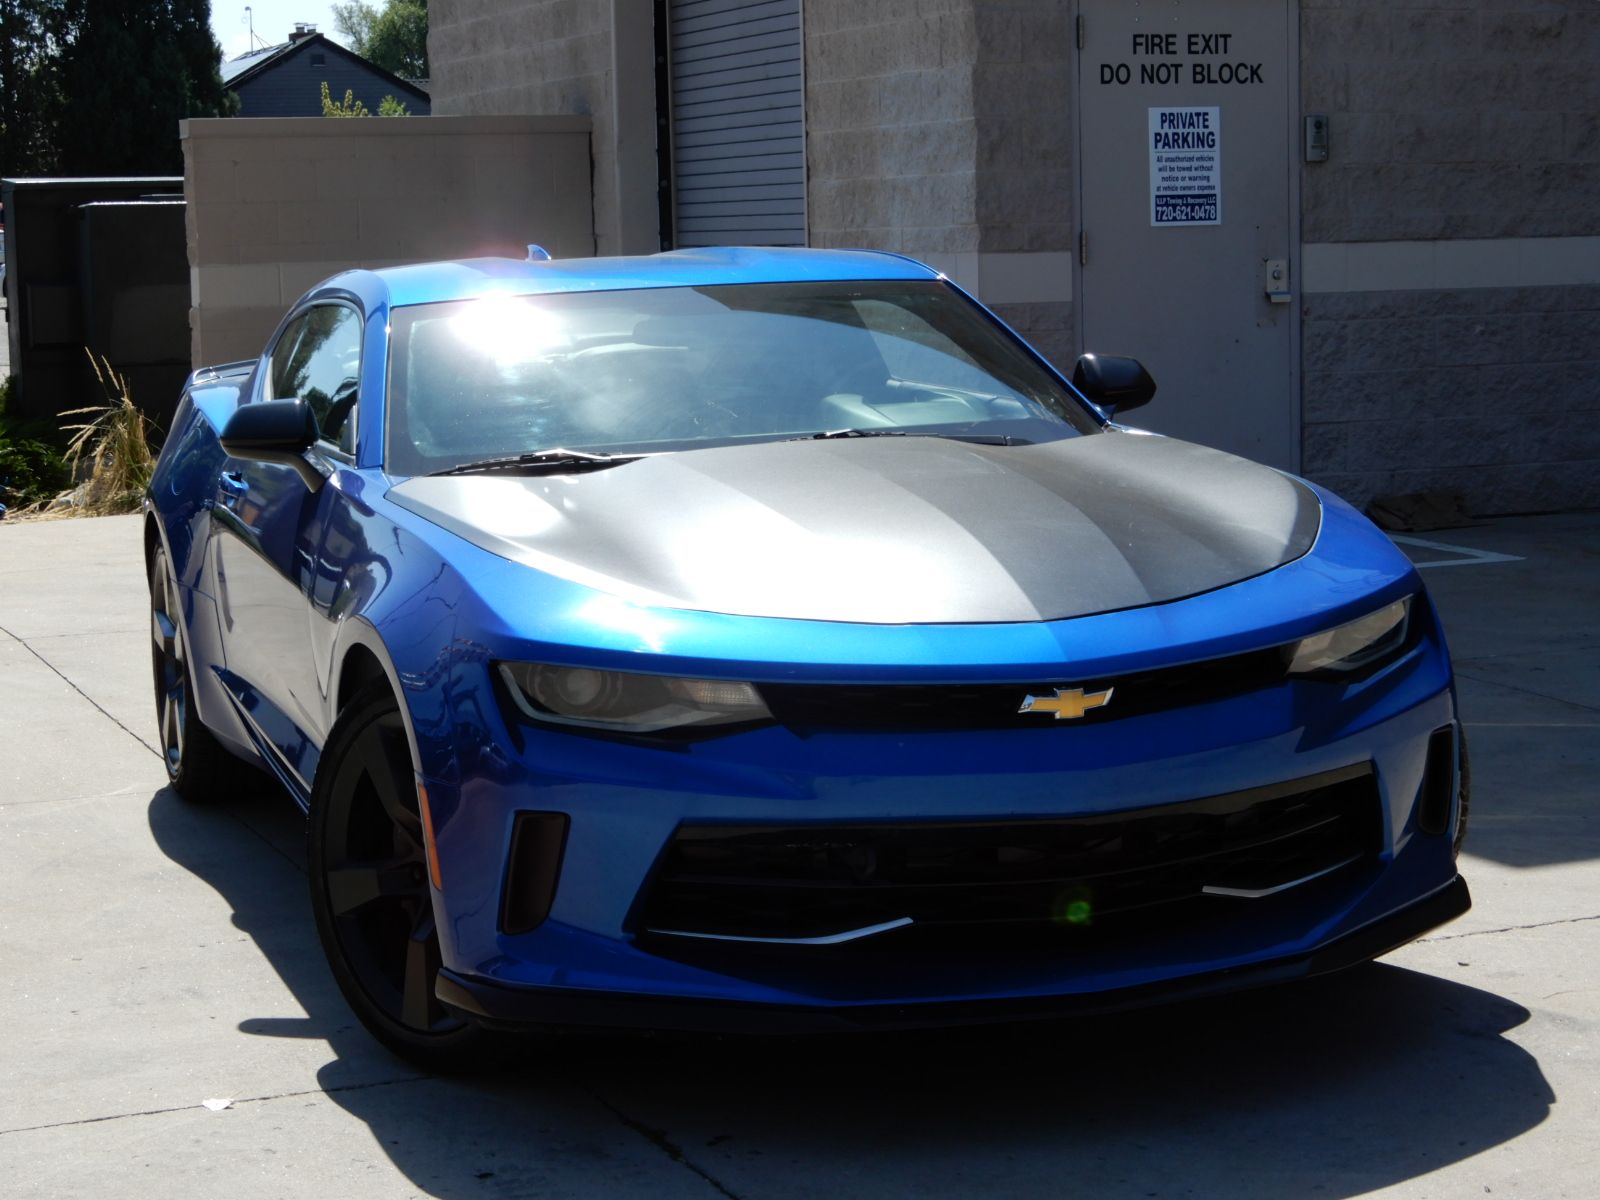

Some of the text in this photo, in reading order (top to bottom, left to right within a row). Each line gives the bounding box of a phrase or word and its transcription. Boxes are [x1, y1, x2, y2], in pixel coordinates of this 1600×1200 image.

[1133, 34, 1232, 55] FIRE EXIT
[1100, 63, 1263, 85] DO NOT BLOCK
[1160, 112, 1209, 129] PRIVATE
[1154, 131, 1215, 149] PARKING
[1188, 175, 1210, 183] warning
[1167, 197, 1182, 205] Towing
[1188, 197, 1207, 205] Recovery
[1156, 205, 1216, 220] 720-621-0478
